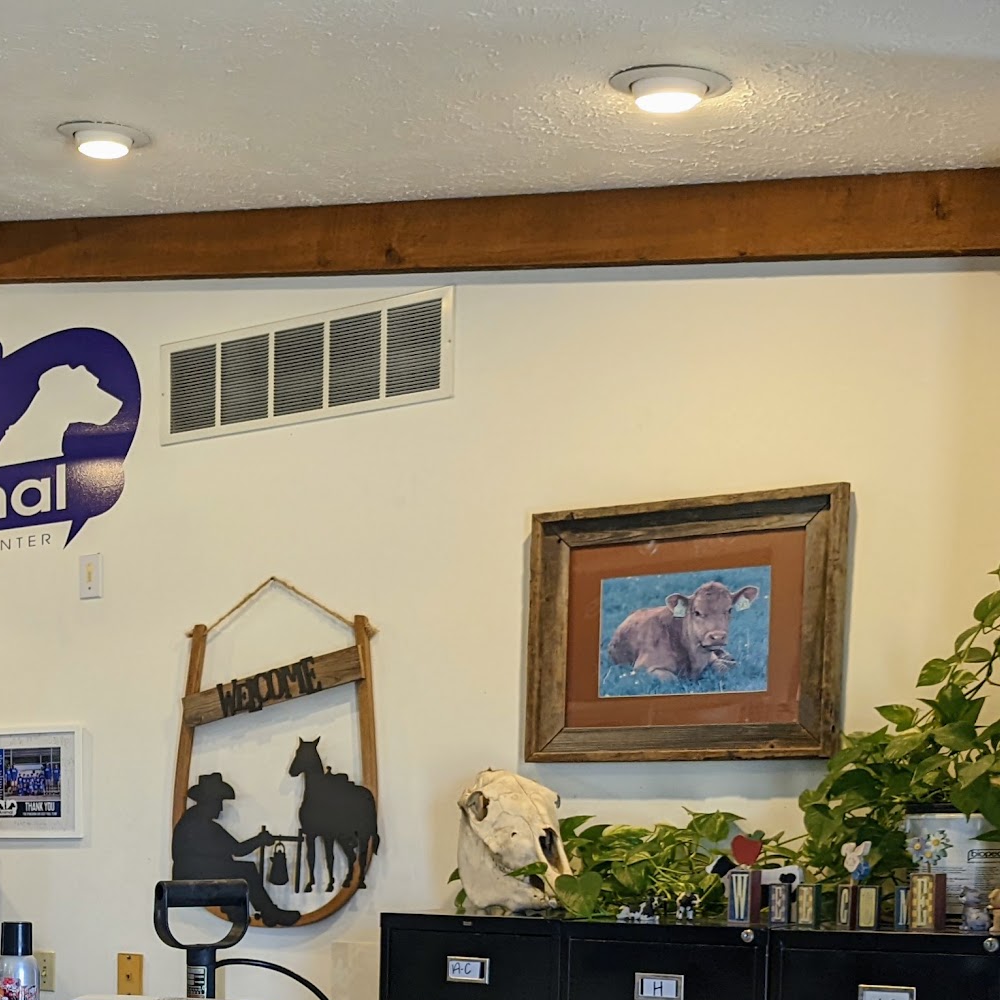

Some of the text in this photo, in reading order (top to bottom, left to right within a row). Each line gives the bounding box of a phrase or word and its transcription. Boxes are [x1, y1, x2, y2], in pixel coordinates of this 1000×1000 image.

[216, 656, 322, 718] WELCOME
[25, 802, 55, 811] THANK YOU
[451, 962, 471, 975] A-C
[653, 980, 663, 996] H
